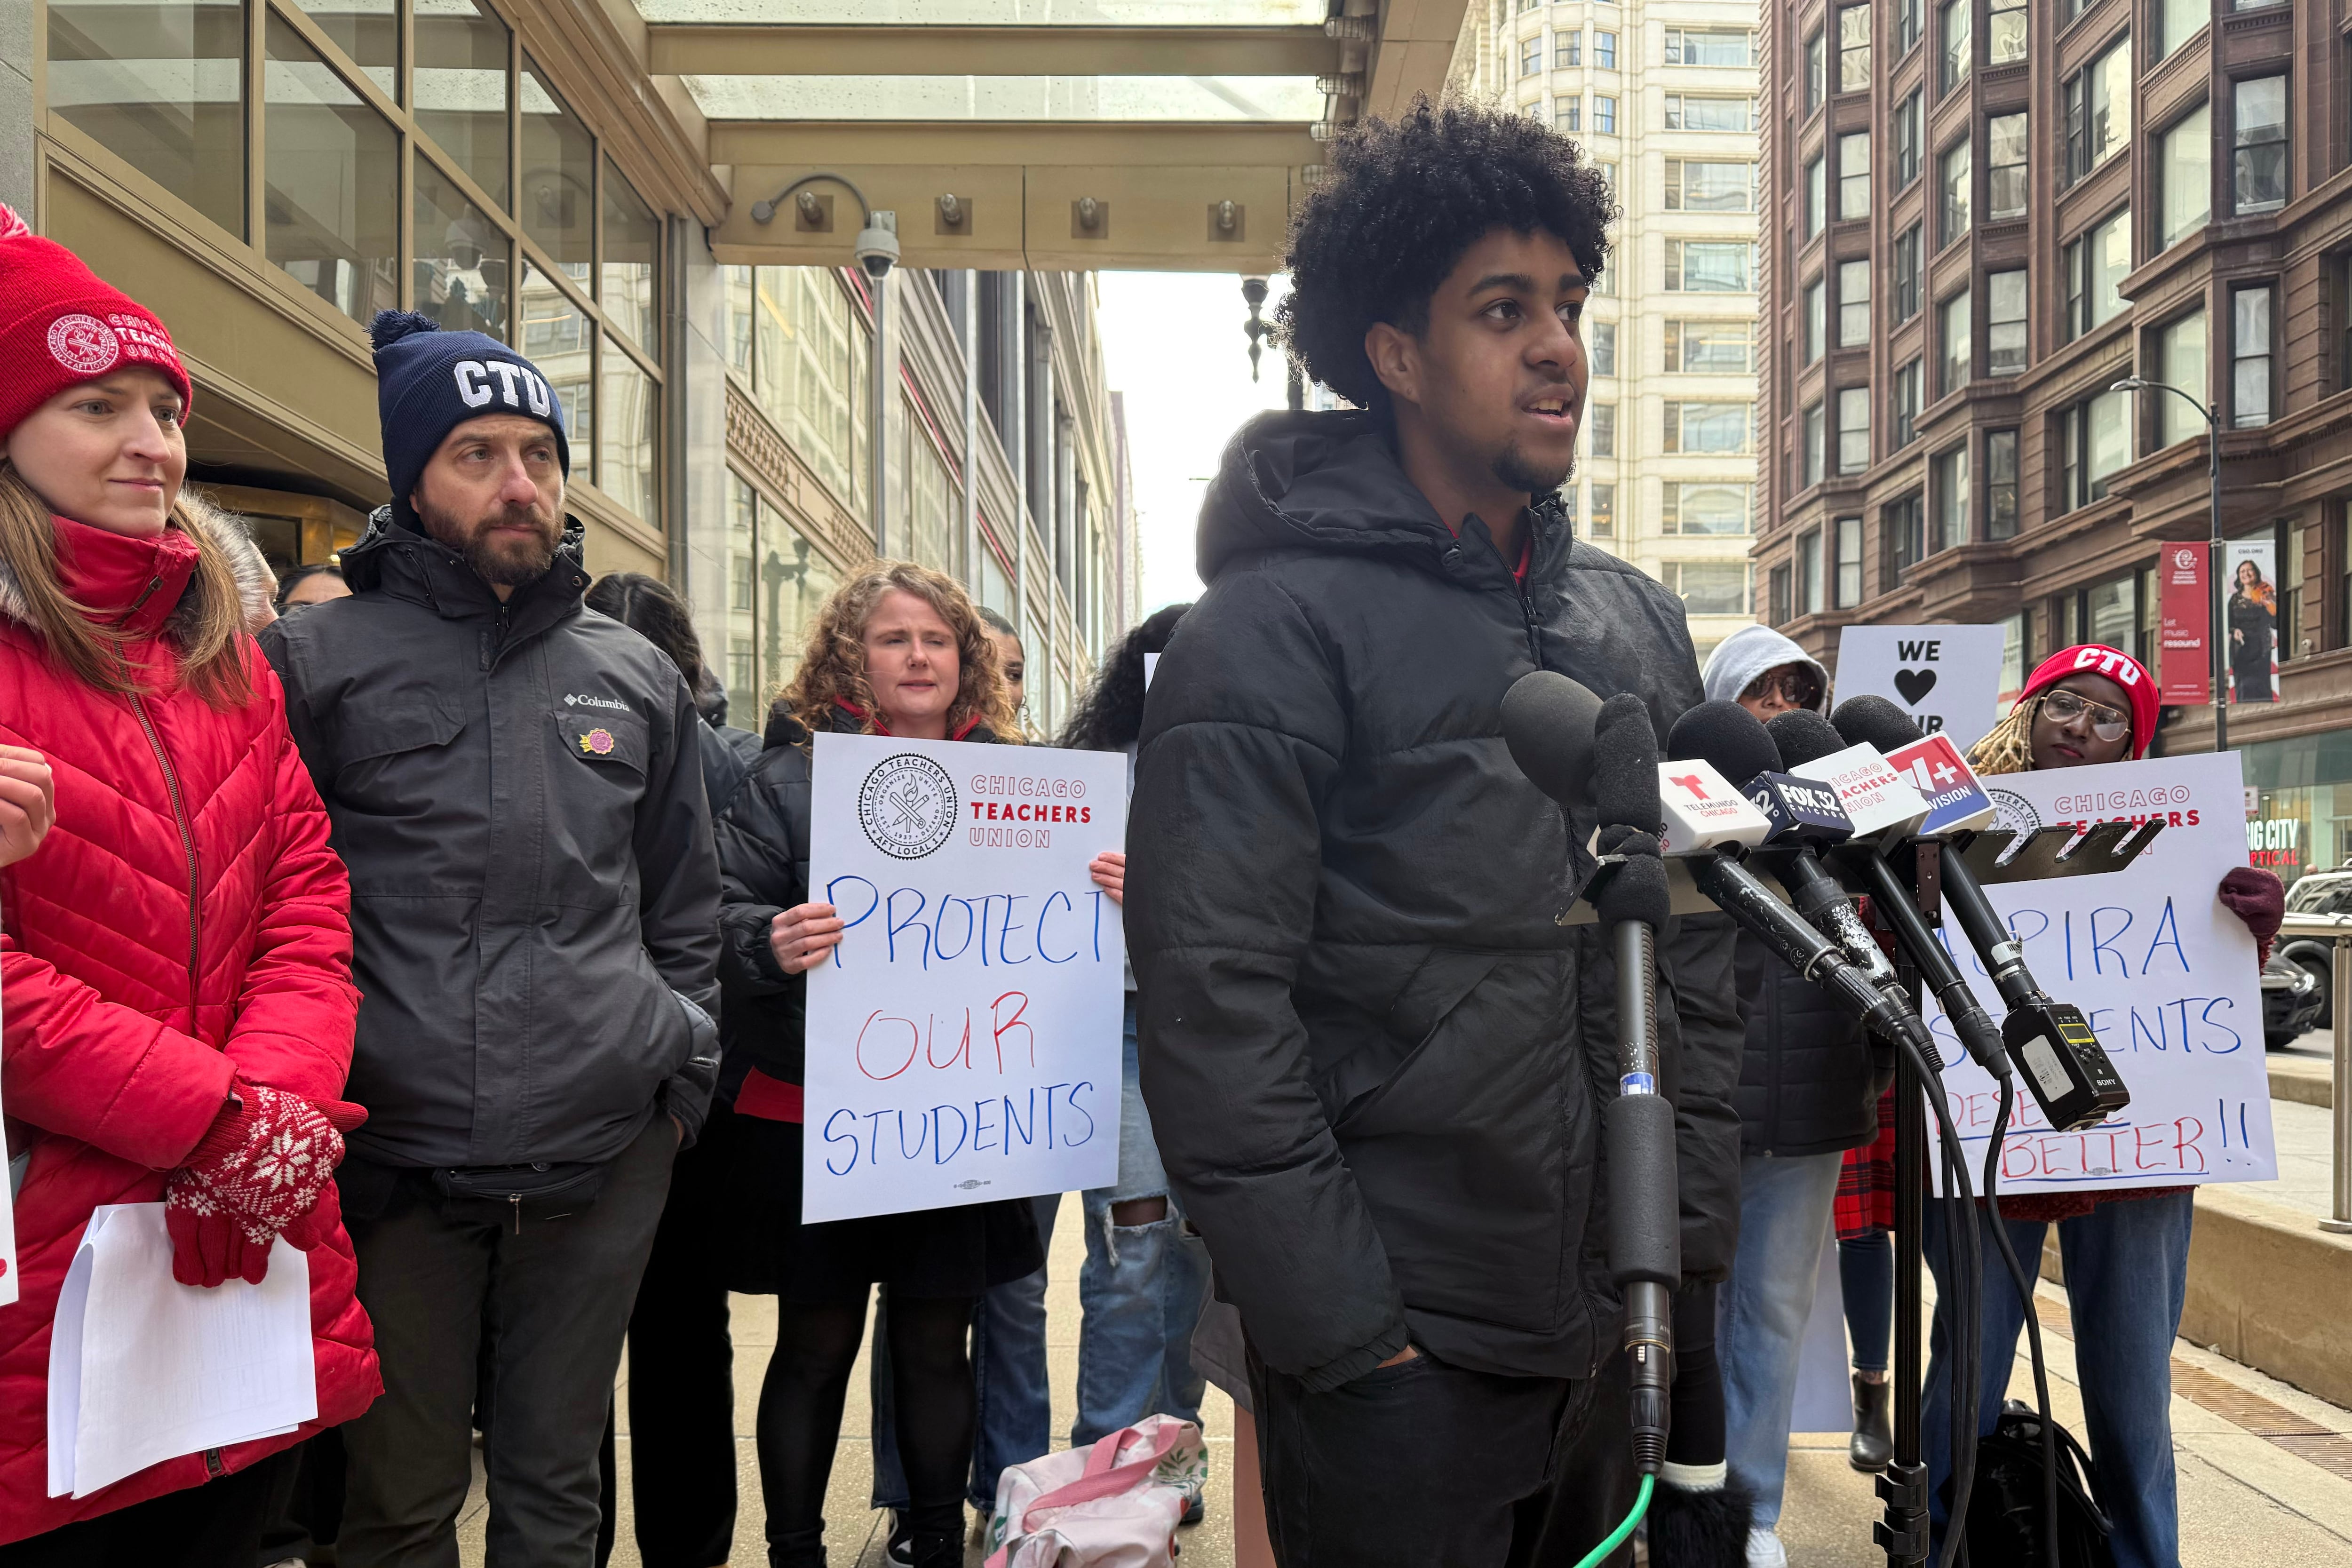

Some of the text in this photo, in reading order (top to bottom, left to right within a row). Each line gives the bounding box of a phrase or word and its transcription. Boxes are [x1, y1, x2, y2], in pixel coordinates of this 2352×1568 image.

[56, 316, 97, 329] TEACHERS
[454, 360, 550, 417] CTU
[1897, 640, 1941, 661] WE
[2163, 637, 2201, 648] resound
[2074, 648, 2141, 685] CTU
[577, 694, 630, 712] Columbia
[970, 774, 1086, 798] CHICAGO
[1827, 763, 1882, 788] ICAGO
[1836, 772, 1898, 801] ACHERS
[863, 758, 953, 828] CHICAGO TEACHERS UNION
[879, 774, 938, 805] ORGANIZE UNITE
[1927, 785, 1972, 810] VISION
[2054, 785, 2190, 814] CHICAGO
[970, 802, 1091, 824] TEACHERS
[1684, 799, 1739, 811] TELEMUNDO
[1700, 807, 1738, 818] CHICAGO
[1789, 804, 1845, 820] CHICAGO
[1843, 792, 1885, 813] NION
[1990, 793, 2026, 810] CHERS
[921, 809, 940, 836] DEFEND
[2265, 818, 2299, 850] CITY
[875, 836, 895, 851] AFT
[897, 843, 931, 855] LOCAL
[894, 831, 912, 840] 1937
[969, 828, 1050, 848] UNION
[2250, 850, 2299, 867] PTICAL
[826, 875, 1104, 971] PROTECT
[857, 991, 1034, 1080] OUR
[824, 1082, 1094, 1175] STUDENTS
